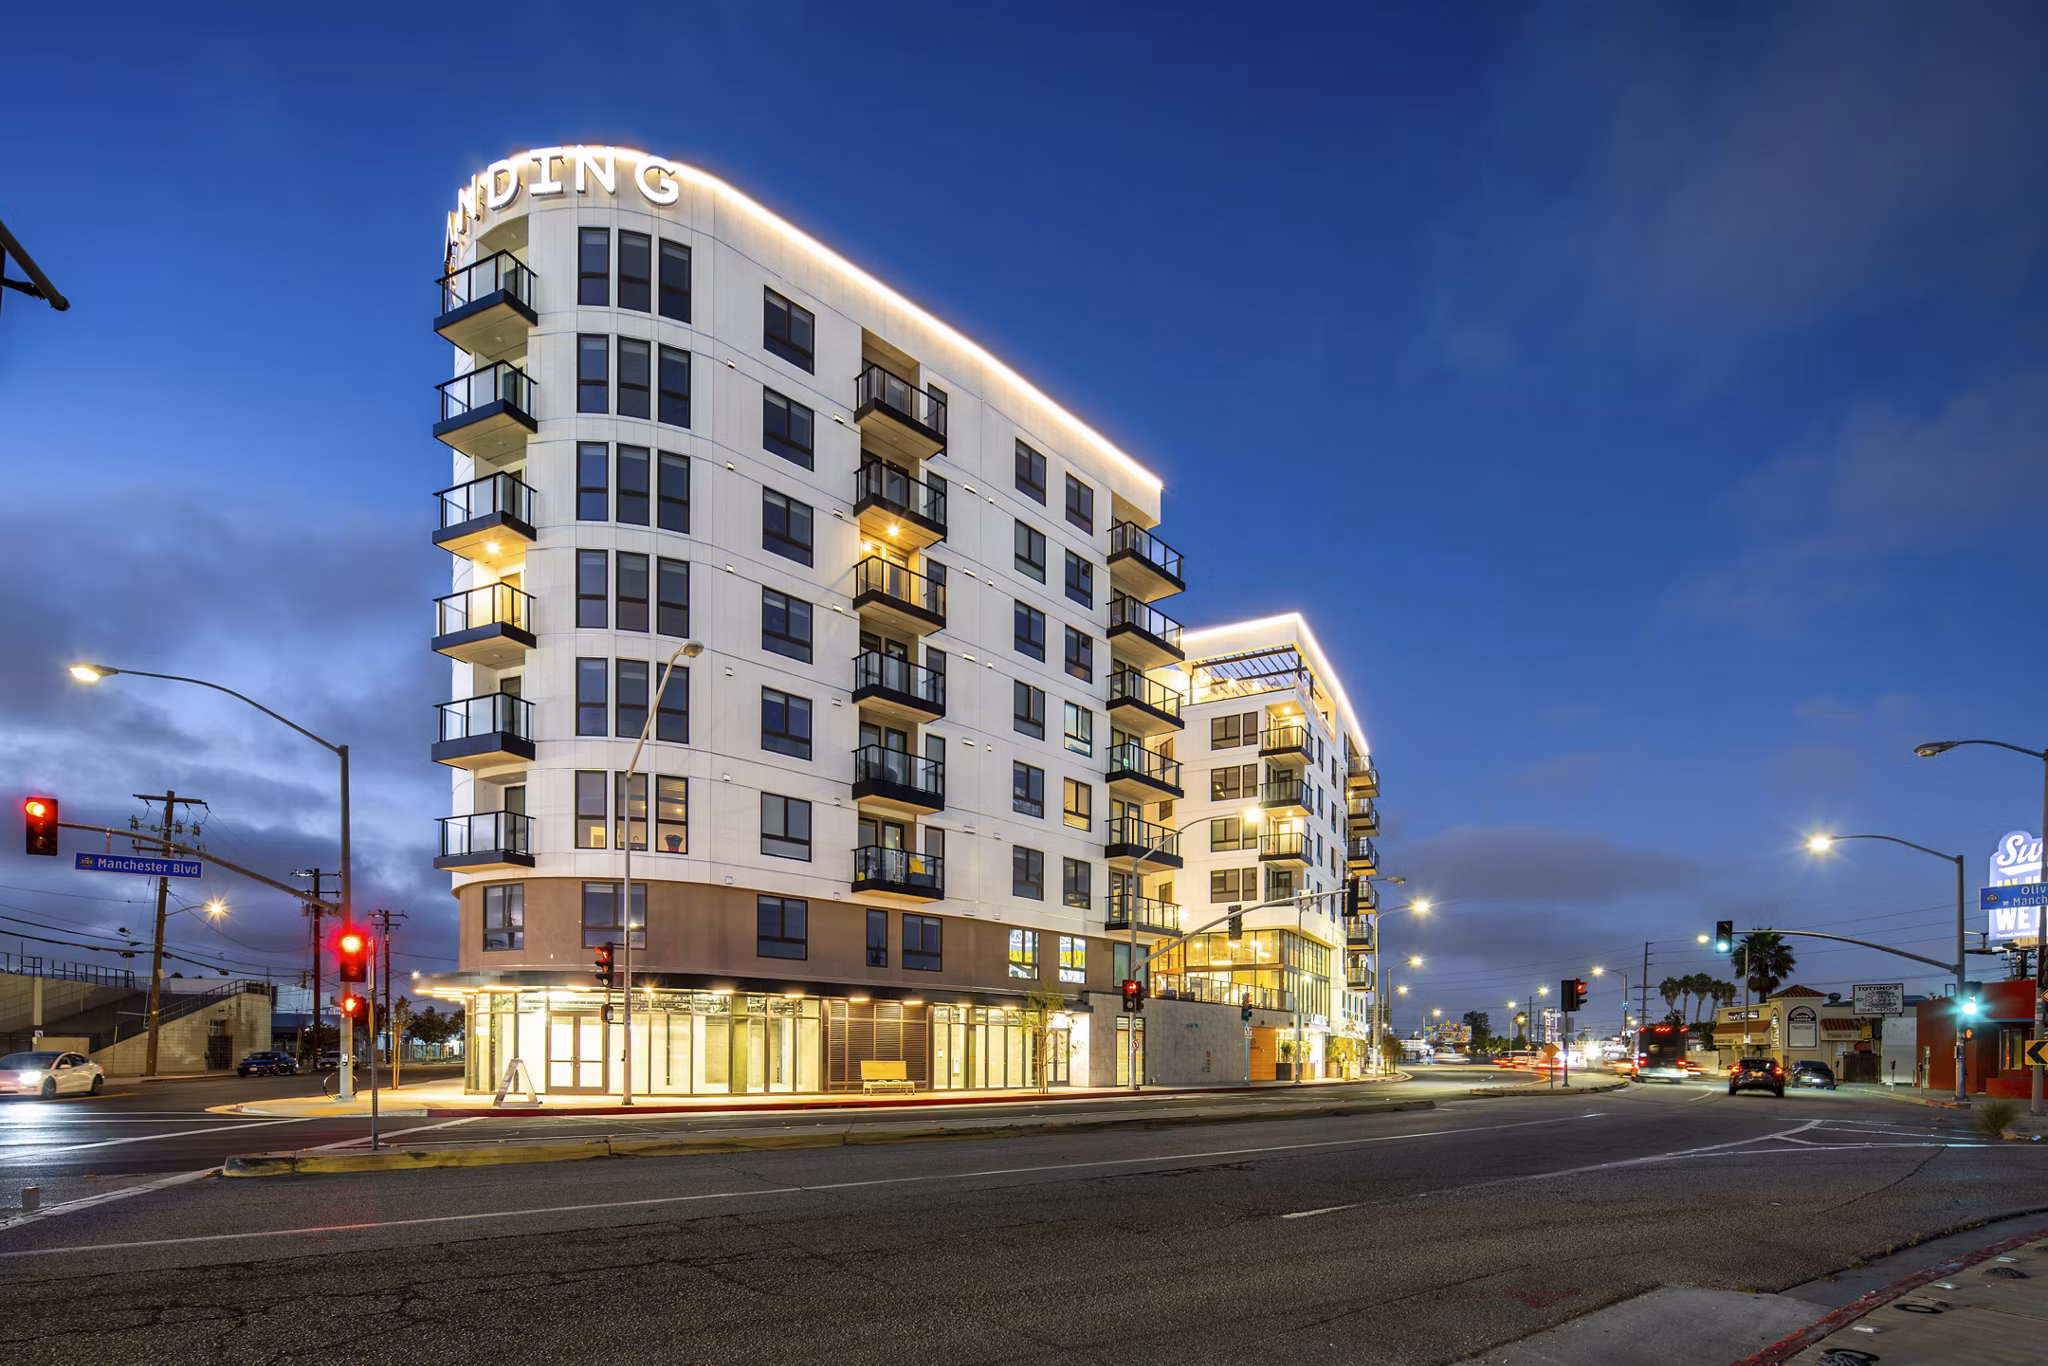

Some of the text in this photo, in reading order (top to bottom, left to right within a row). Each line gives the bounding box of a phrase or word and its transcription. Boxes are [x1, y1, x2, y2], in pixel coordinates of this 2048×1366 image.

[98, 858, 168, 872] Manchester
[173, 863, 198, 874] Blvd
[2021, 885, 2047, 895] Oliv
[2013, 894, 2048, 906] Manch
